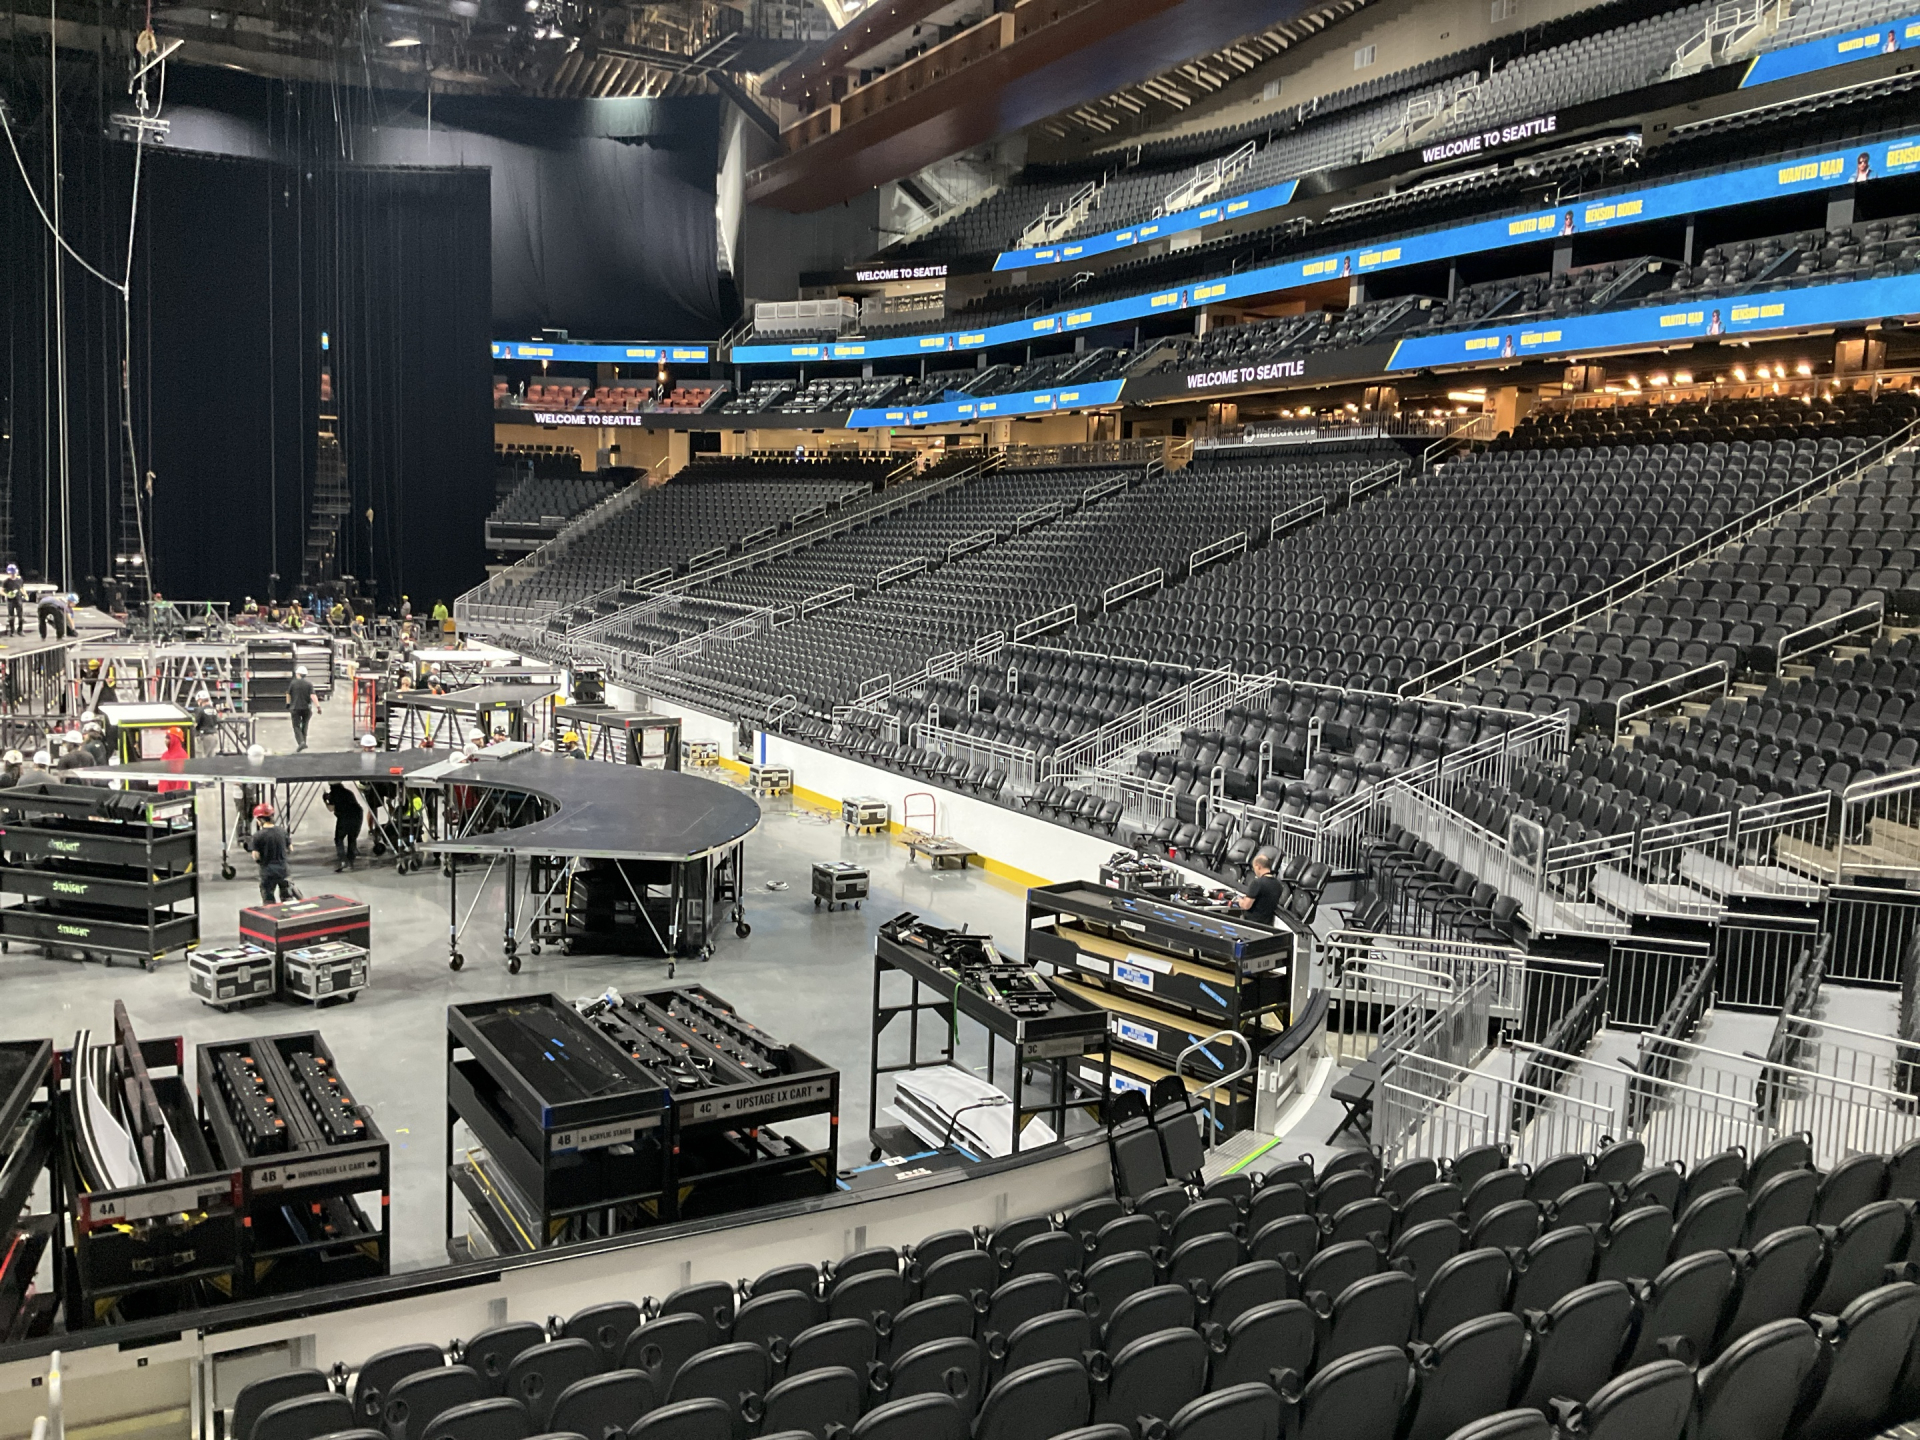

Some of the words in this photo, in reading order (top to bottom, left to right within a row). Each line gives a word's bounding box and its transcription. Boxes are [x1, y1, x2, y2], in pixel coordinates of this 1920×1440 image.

[1422, 135, 1482, 163] WELCOME
[1483, 131, 1501, 148] TO
[1502, 116, 1557, 143] SEATTLE
[1778, 162, 1819, 184] WANTED
[1820, 157, 1844, 176] MAN
[1585, 205, 1616, 223] BENSON
[1508, 218, 1537, 236] WANTED
[1538, 214, 1556, 230] MAN
[856, 269, 899, 281] WELCOME
[900, 268, 913, 279] TO
[913, 265, 948, 277] SEATTLE
[1187, 369, 1238, 389] WELCOME
[1240, 367, 1255, 382] TO
[1256, 360, 1305, 381] SEATTLE
[534, 413, 586, 425] WELCOME
[587, 415, 601, 425] TO
[602, 415, 642, 426] SEATTLE
[1294, 426, 1316, 437] CLUB
[52, 881, 88, 894] STRAIGHT
[57, 924, 90, 937] STRAIGHT
[1027, 1044, 1038, 1054] 3C
[699, 1102, 712, 1113] 4C
[736, 1092, 775, 1109] UPSTAGE
[777, 1090, 788, 1102] LX
[789, 1086, 812, 1099] CART
[557, 1134, 571, 1146] 4B
[589, 1131, 612, 1142] ACRYLIC
[613, 1127, 632, 1137] STAIRS
[261, 1170, 277, 1183] 4B
[298, 1165, 337, 1179] DOWNSTAGE
[348, 1161, 365, 1172] CART
[99, 1202, 116, 1215] 4A
